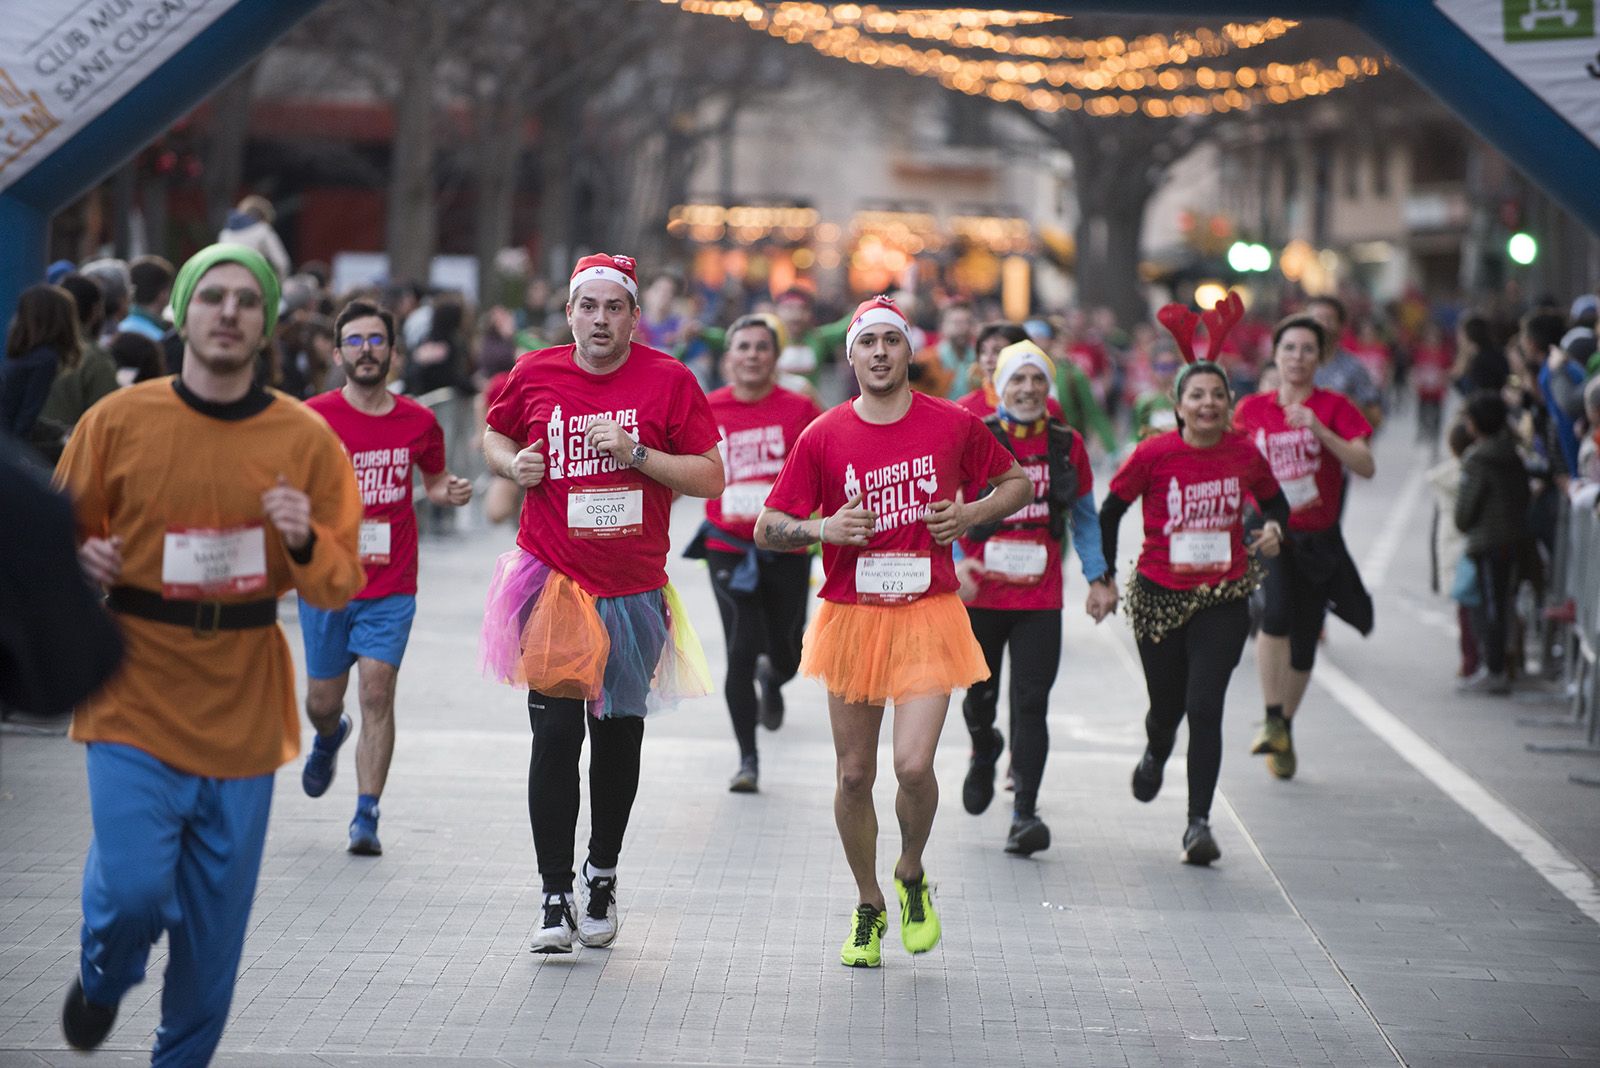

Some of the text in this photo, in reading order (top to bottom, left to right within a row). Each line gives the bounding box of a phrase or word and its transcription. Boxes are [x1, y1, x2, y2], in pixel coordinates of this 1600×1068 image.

[35, 28, 90, 76] CLUB
[55, 0, 187, 101] SANT CUGA
[615, 408, 639, 427] DEL
[567, 460, 600, 477] SANT
[865, 454, 936, 491] CURSA DEL
[586, 503, 625, 514] OSCAR
[867, 480, 920, 519] GALL
[595, 515, 617, 525] 670
[873, 511, 899, 534] ANT
[882, 580, 903, 591] 673
